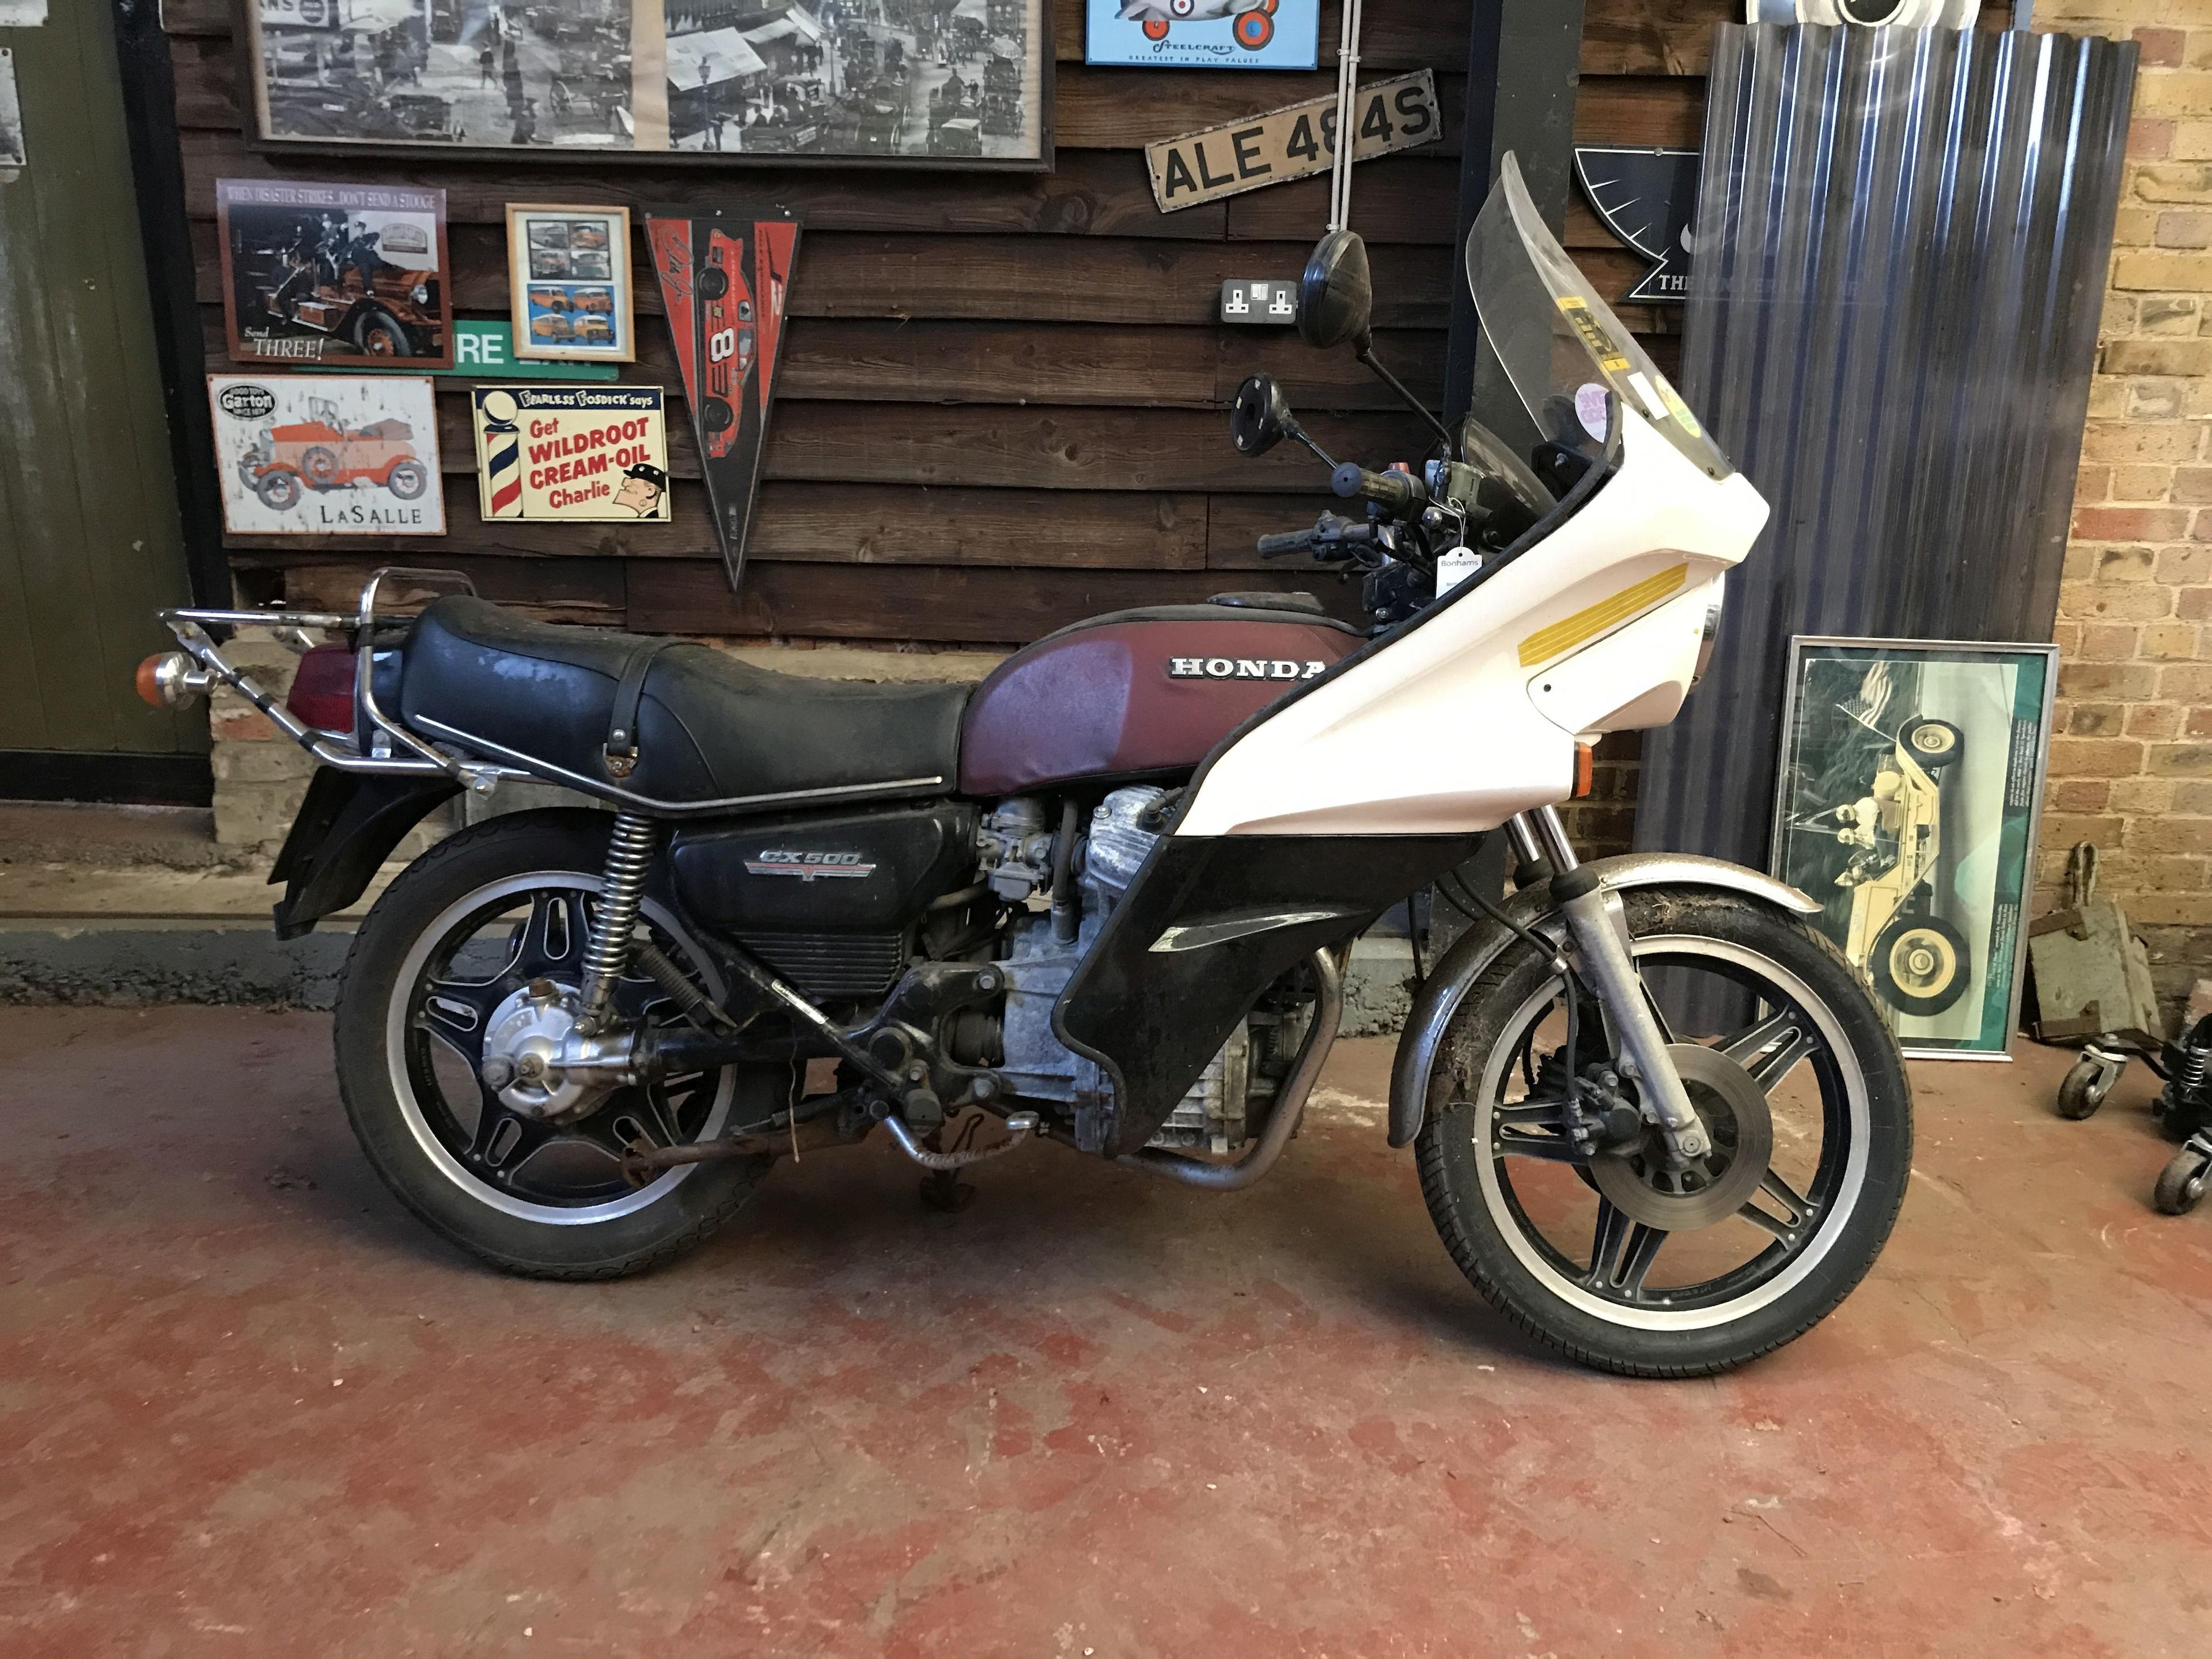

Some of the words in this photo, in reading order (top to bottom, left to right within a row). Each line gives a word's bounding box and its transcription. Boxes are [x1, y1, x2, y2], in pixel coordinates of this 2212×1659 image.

[1165, 126, 1271, 199] ALE
[368, 192, 391, 207] SEND
[393, 194, 399, 208] A
[400, 193, 435, 209] STOOGE
[244, 326, 269, 337] Send
[254, 338, 324, 361] THREE!
[710, 327, 734, 362] 8
[222, 393, 272, 409] Garton
[518, 389, 575, 408] FEARLESS
[630, 396, 653, 408] says
[530, 417, 559, 438] Get
[528, 416, 649, 464] WILDROOT
[529, 444, 650, 489] CREAM-OIL
[549, 481, 610, 509] Charlie
[1170, 657, 1325, 680] HONDA
